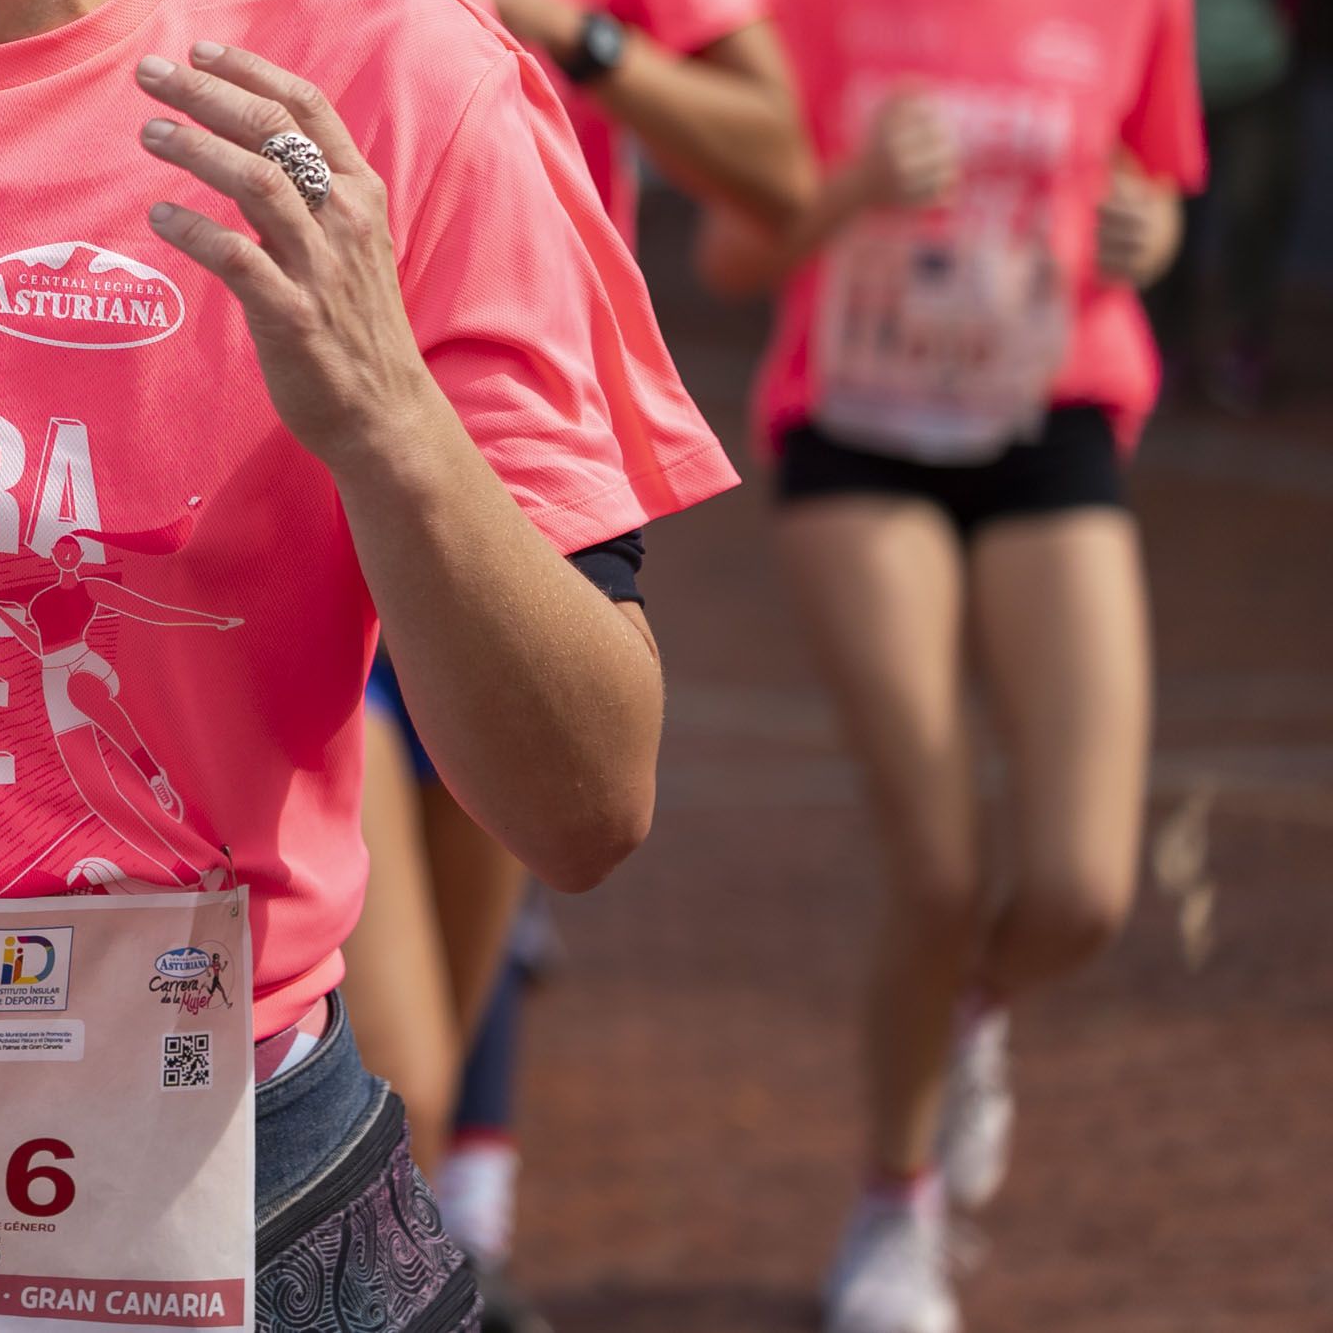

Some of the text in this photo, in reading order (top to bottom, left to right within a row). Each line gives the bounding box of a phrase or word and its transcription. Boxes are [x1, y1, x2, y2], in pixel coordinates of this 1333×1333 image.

[18, 273, 165, 297] CENTRAL LECHERA
[149, 976, 198, 992] Carrera
[4, 995, 56, 1006] DEPORTES
[161, 993, 171, 1004] de
[178, 990, 212, 1015] Mujer
[3, 1219, 57, 1233] GÉNERO
[20, 1285, 97, 1313] GRAN
[104, 1290, 226, 1318] CANARIA
